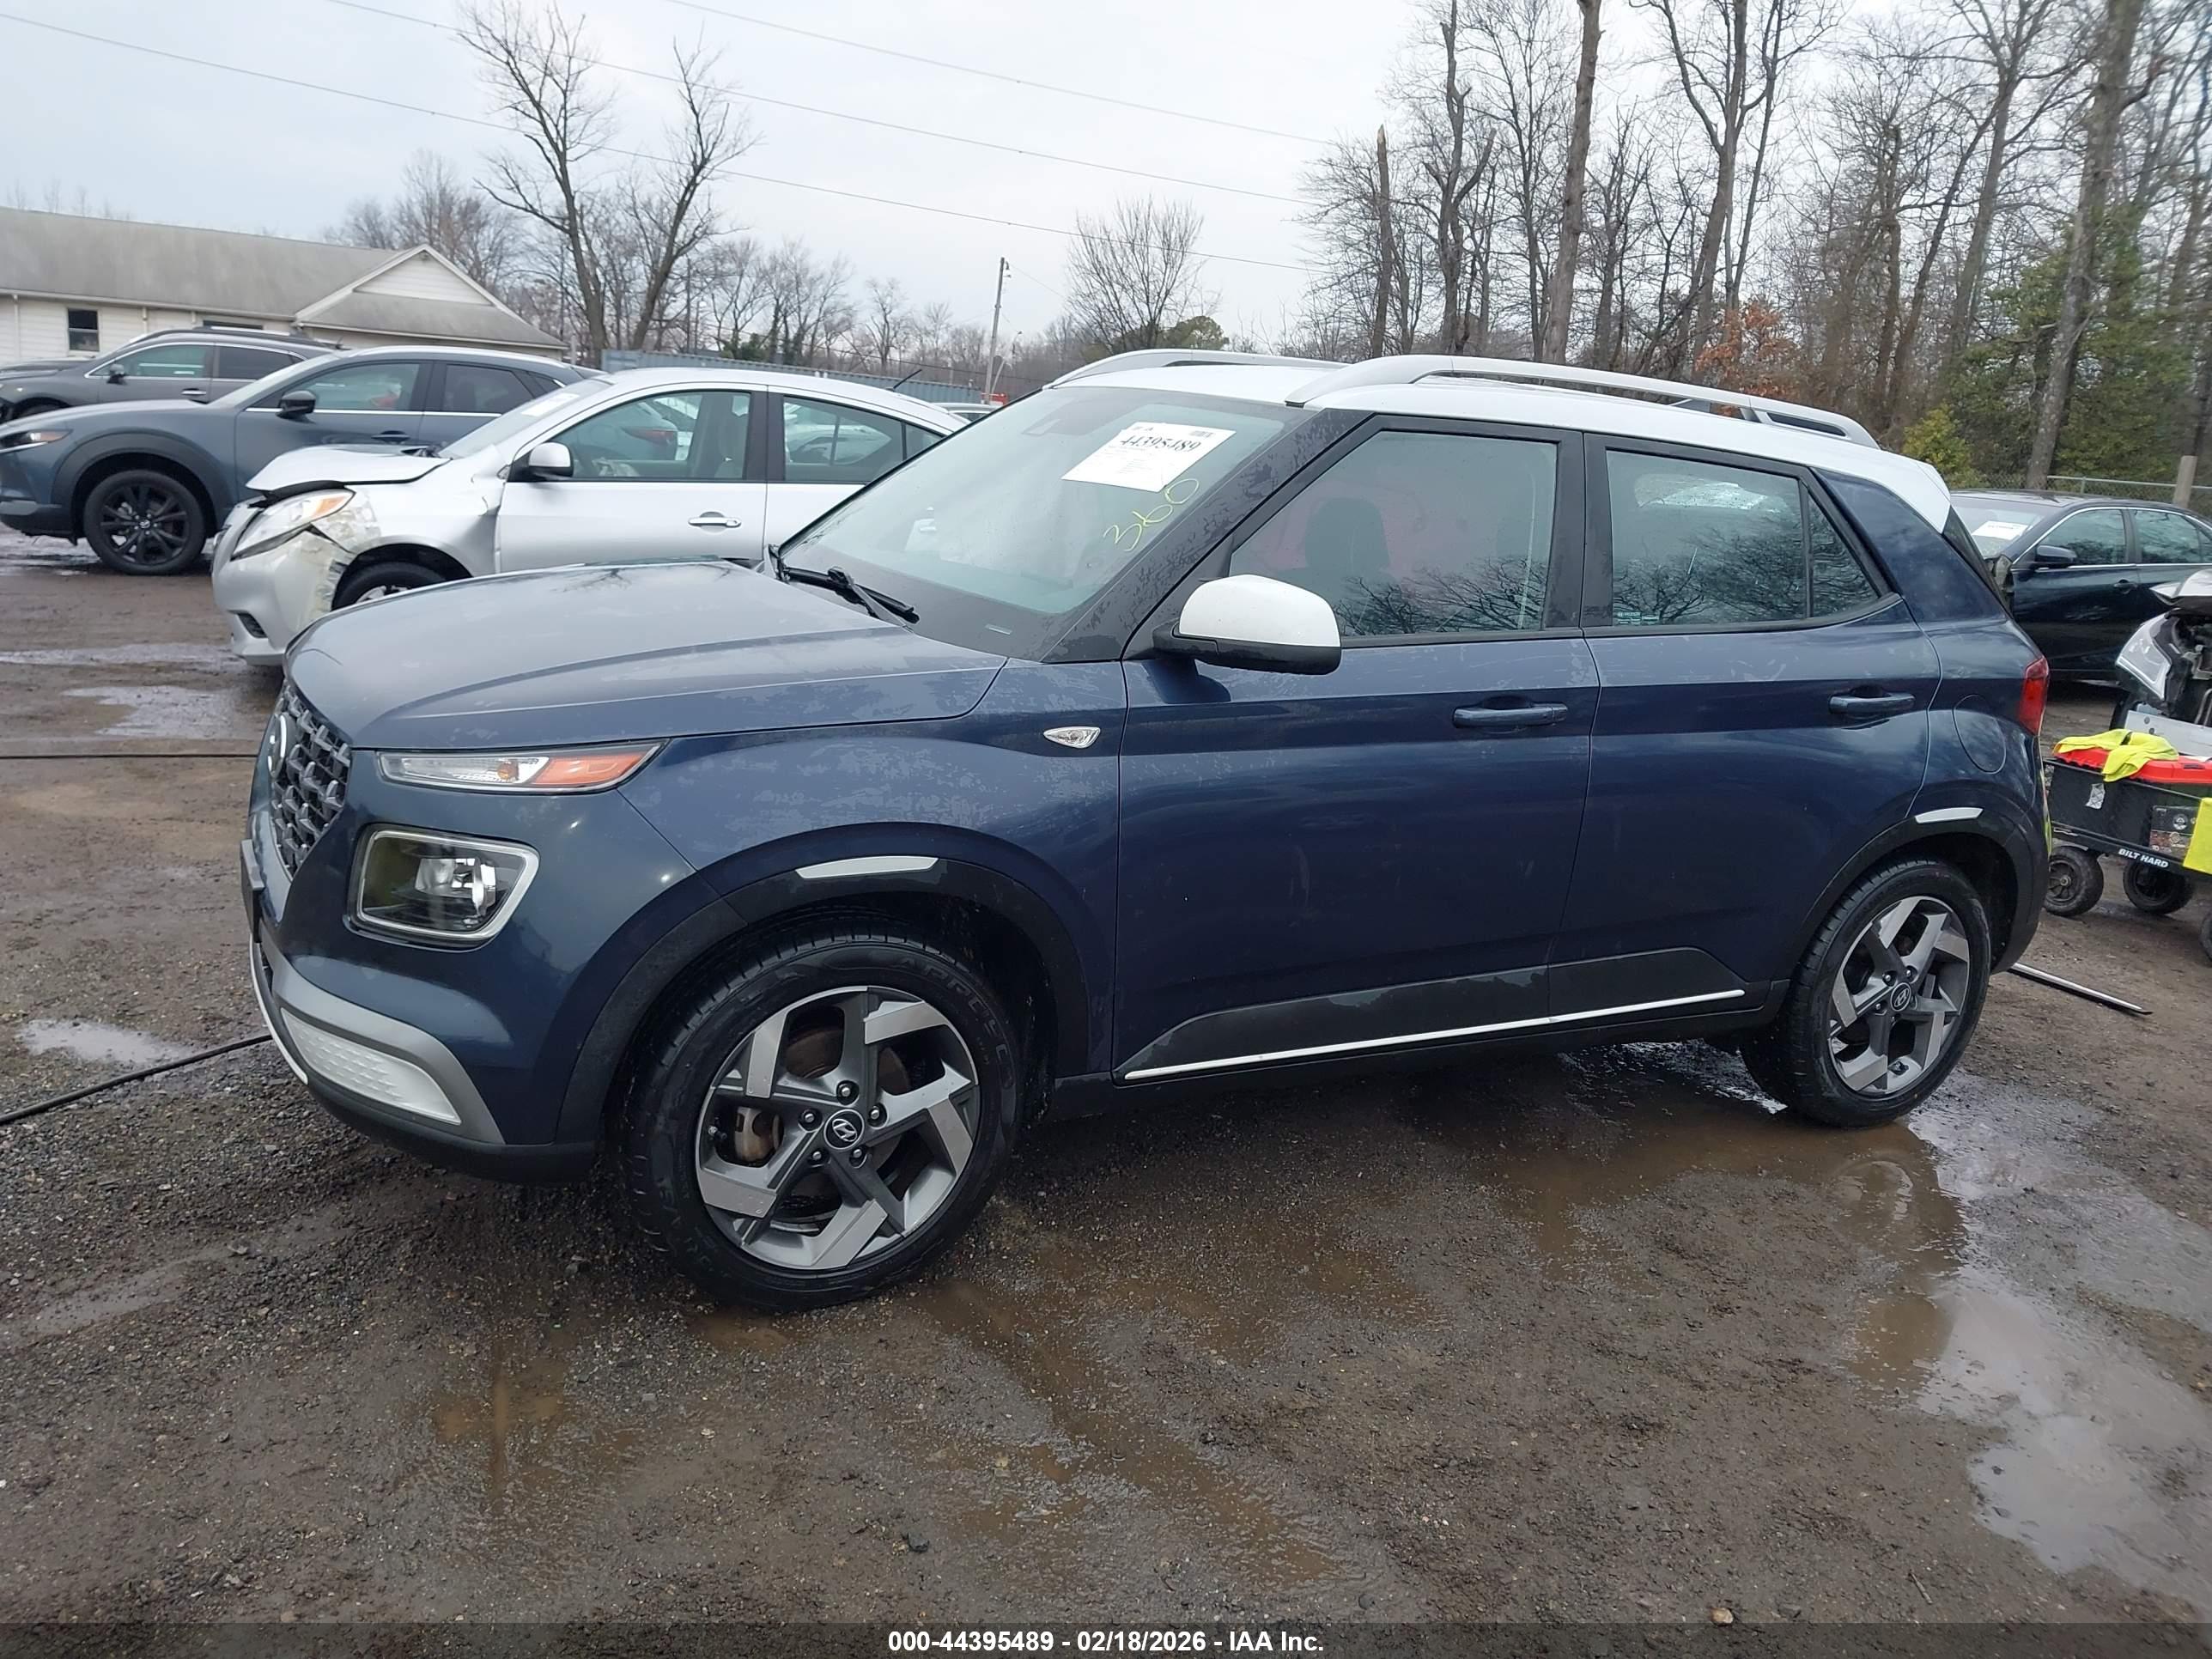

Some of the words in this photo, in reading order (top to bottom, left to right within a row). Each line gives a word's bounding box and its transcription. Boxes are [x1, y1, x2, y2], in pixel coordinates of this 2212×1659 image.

[1120, 435, 1201, 452] 44395489
[2118, 848, 2140, 860] BILT
[2141, 855, 2168, 868] HARD
